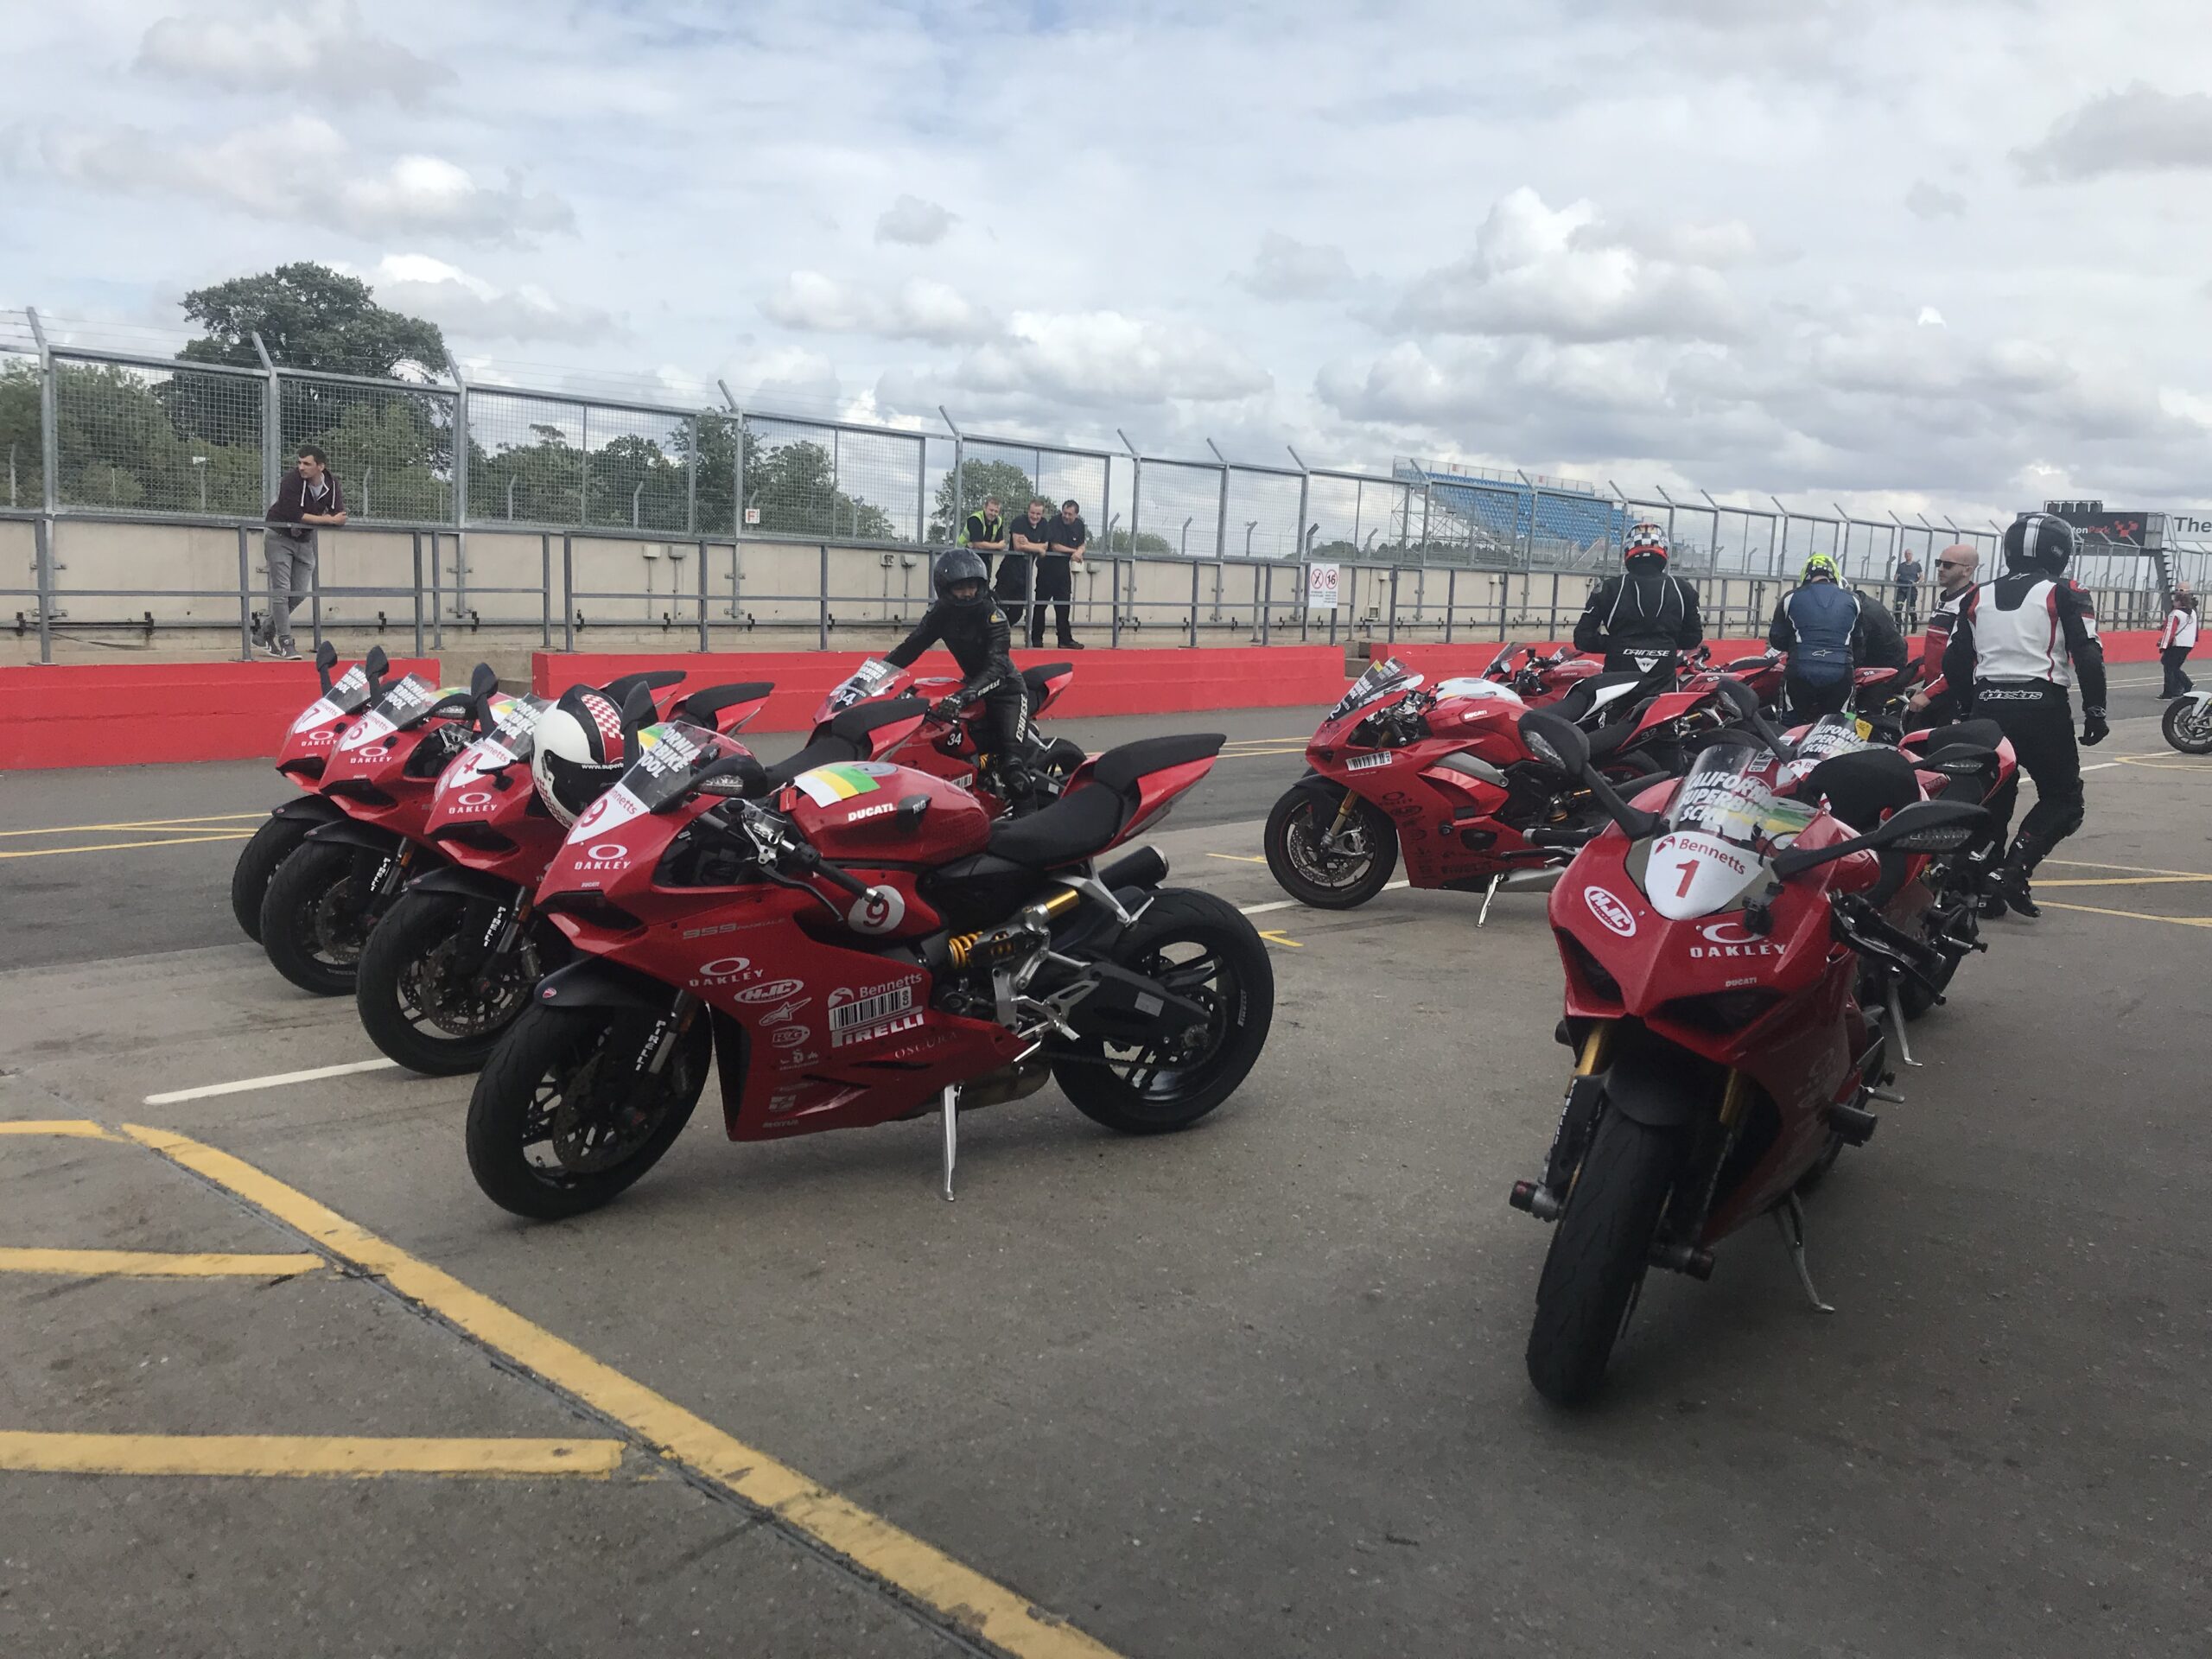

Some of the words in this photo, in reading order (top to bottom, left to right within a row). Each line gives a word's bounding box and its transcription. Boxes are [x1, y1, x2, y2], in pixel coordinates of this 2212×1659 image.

[2174, 517, 2212, 533] The
[1623, 648, 1670, 657] DAINESE
[835, 690, 856, 707] 34
[1979, 689, 2043, 701] alpinestars
[1015, 693, 1028, 743] DAINESE
[349, 721, 368, 741] 6
[947, 733, 962, 746] 34
[463, 753, 484, 774] 4
[448, 804, 498, 815] OAKLEY
[581, 798, 608, 828] 9
[848, 803, 894, 822] DUCATI
[574, 861, 632, 870] OAKLEY
[1678, 837, 1746, 875] Bennetts
[370, 856, 391, 892] PIRELLI
[1675, 859, 1700, 899] 1
[862, 898, 890, 928] 9
[1588, 891, 1632, 929] HJC
[484, 906, 506, 947] PIRELLI
[1690, 944, 1787, 958] OAKLEY
[689, 969, 764, 987] OAKLEY
[859, 973, 923, 999] Bennetts
[1725, 977, 1757, 988] DUCATI
[744, 981, 794, 1001] HJC
[831, 1006, 925, 1048] PIRELLI
[635, 1020, 666, 1071] PIRELLI
